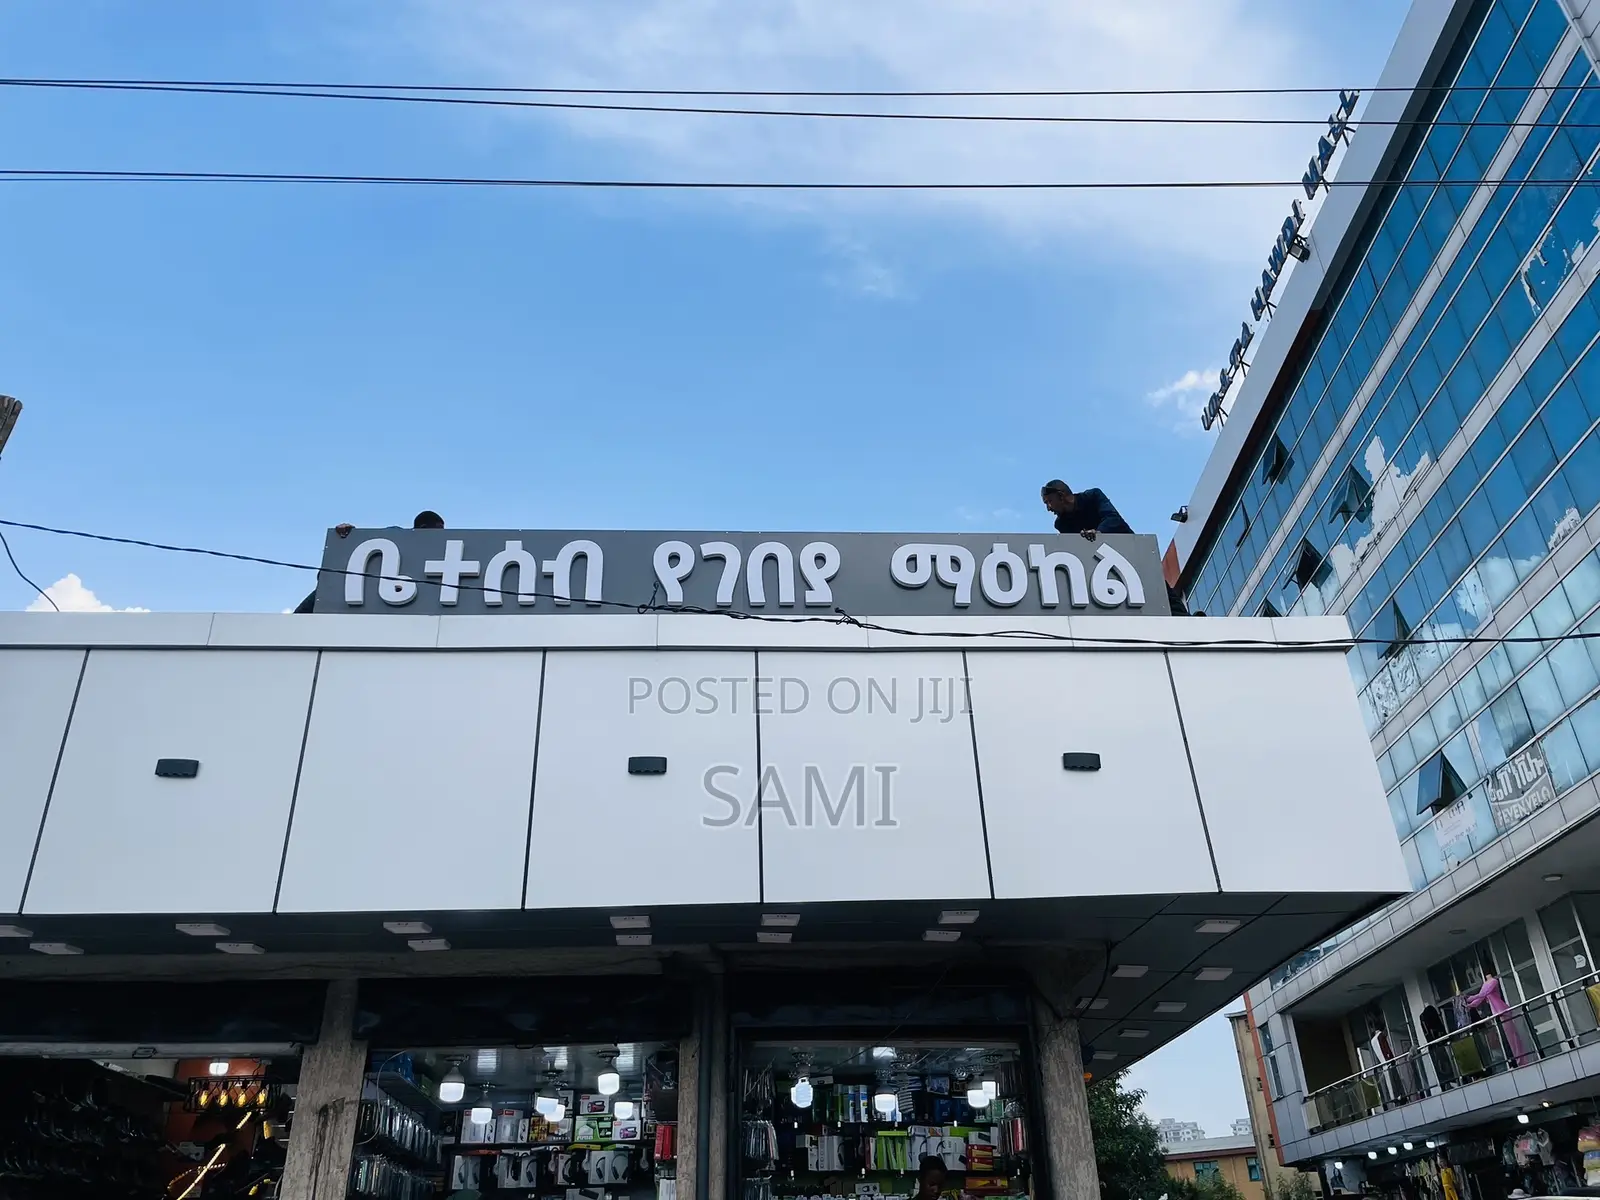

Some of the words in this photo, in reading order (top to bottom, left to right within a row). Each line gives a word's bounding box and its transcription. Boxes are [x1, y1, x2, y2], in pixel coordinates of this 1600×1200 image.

[344, 537, 604, 607] ቤተሰብ
[652, 540, 842, 608] የገበያ
[890, 542, 1147, 609] ማዕከል
